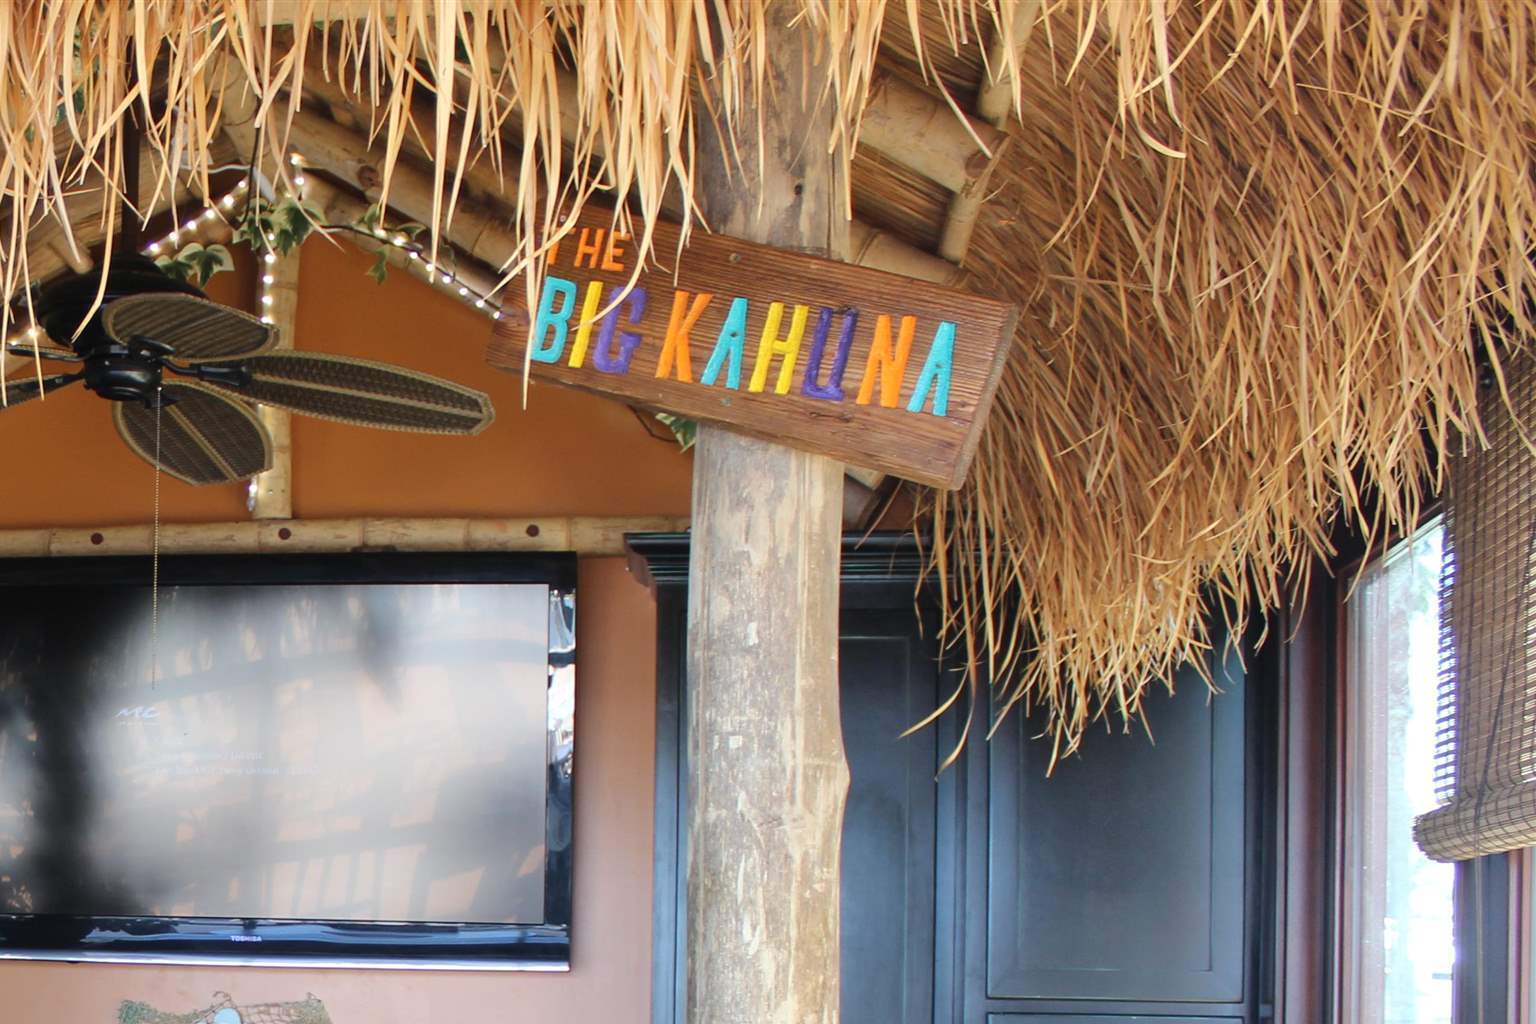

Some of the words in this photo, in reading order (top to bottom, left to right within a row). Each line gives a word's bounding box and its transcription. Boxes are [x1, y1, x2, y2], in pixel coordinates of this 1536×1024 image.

[541, 226, 632, 272] THE
[530, 275, 647, 375] BIG
[654, 289, 956, 416] KAHUNA
